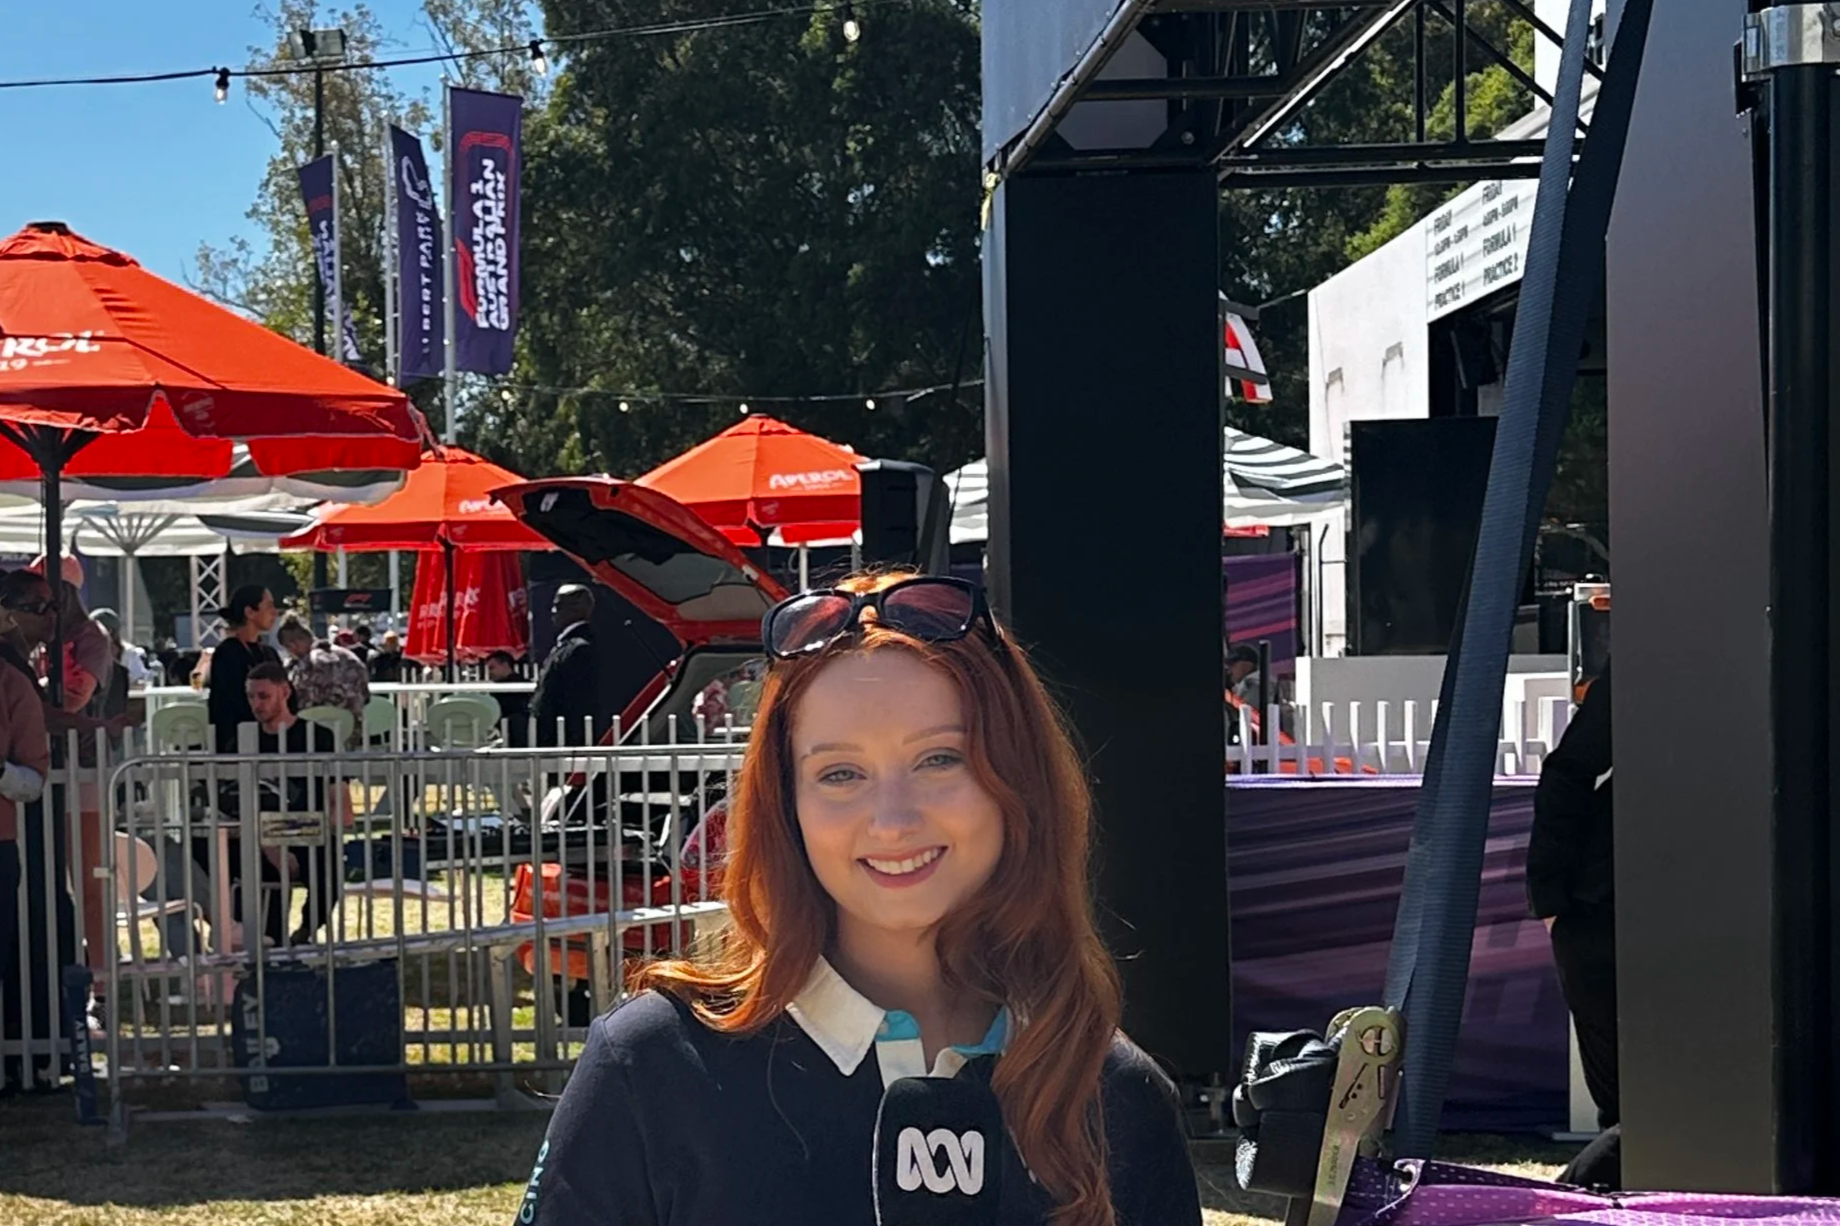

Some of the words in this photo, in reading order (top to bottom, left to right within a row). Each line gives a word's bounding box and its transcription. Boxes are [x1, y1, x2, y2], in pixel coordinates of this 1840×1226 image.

[470, 179, 485, 195] 1
[472, 200, 490, 329] FORMULA
[1483, 255, 1513, 287] PRACTICE
[496, 237, 510, 331] GRAND
[769, 469, 854, 490] APEROL
